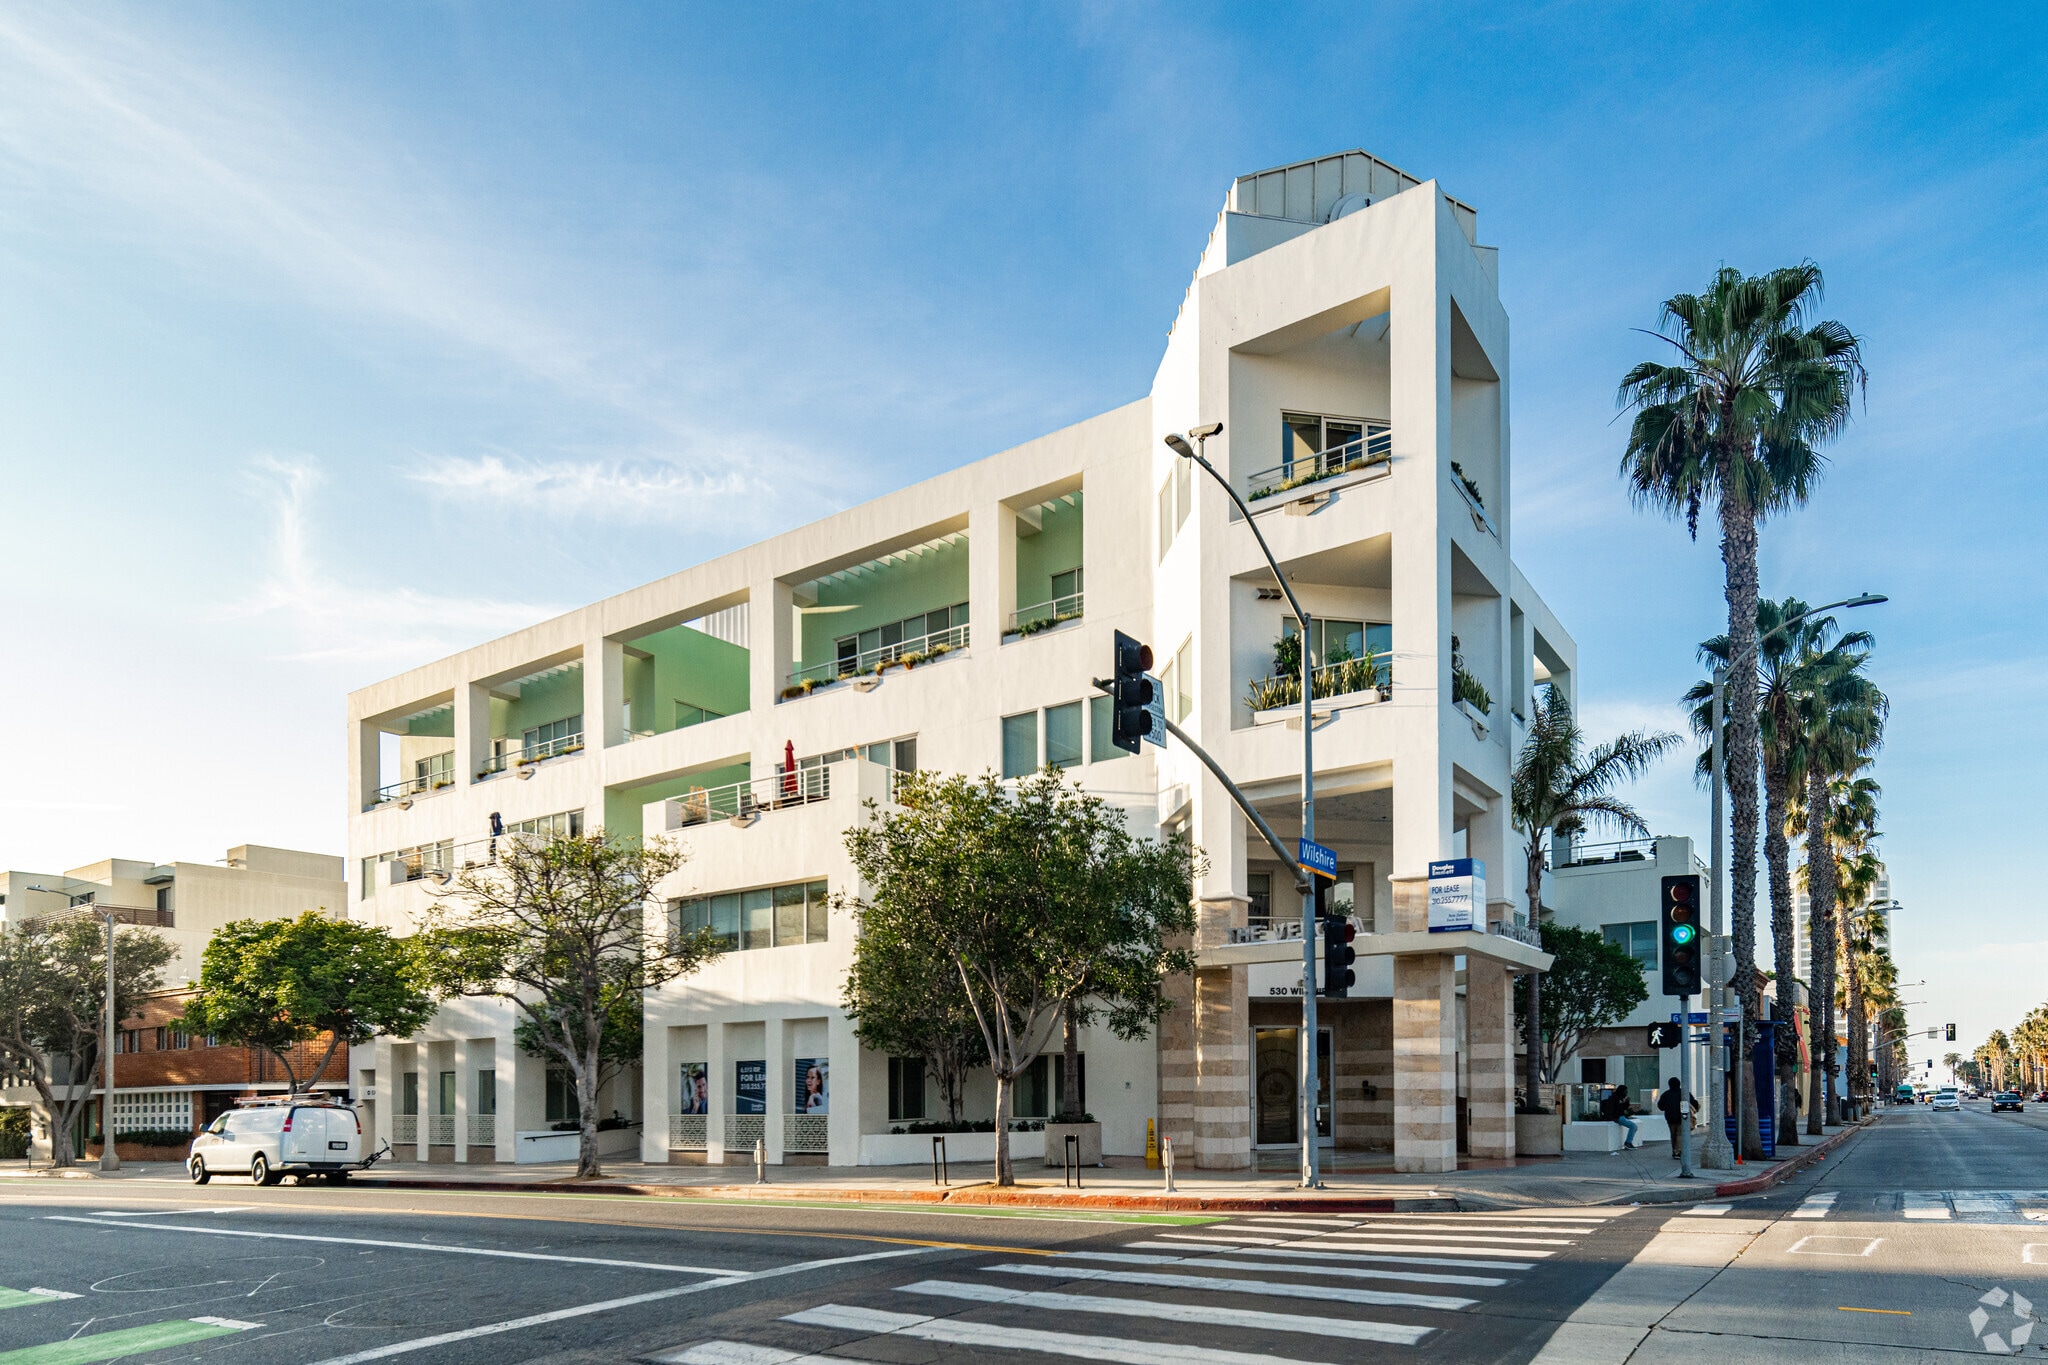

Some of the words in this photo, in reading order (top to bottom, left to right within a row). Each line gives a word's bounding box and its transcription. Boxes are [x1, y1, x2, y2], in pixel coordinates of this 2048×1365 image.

[1302, 842, 1334, 869] Wilshire
[1432, 886, 1442, 894] FOR
[1444, 884, 1459, 893] LEASE
[1228, 924, 1268, 944] THE
[1270, 987, 1288, 996] 530
